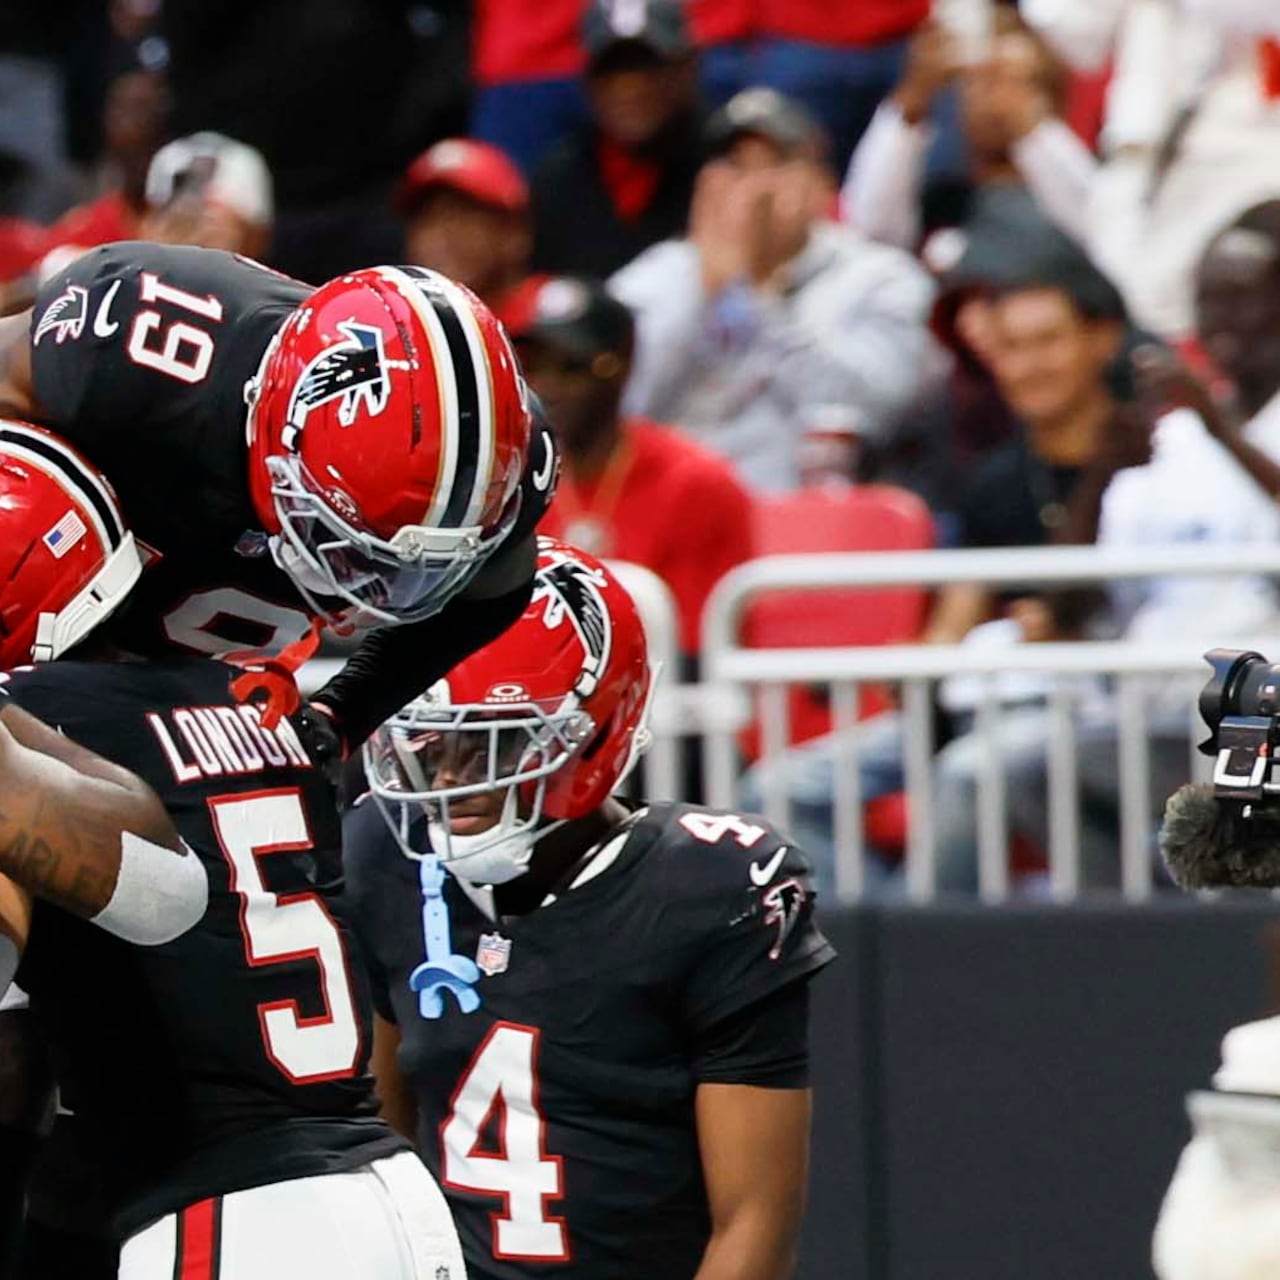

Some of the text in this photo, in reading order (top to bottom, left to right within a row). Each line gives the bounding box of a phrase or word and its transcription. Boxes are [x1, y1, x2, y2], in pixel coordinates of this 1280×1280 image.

[125, 265, 223, 386] 19
[676, 811, 769, 850] 4
[206, 788, 364, 1086] 5
[439, 1020, 572, 1262] 4
